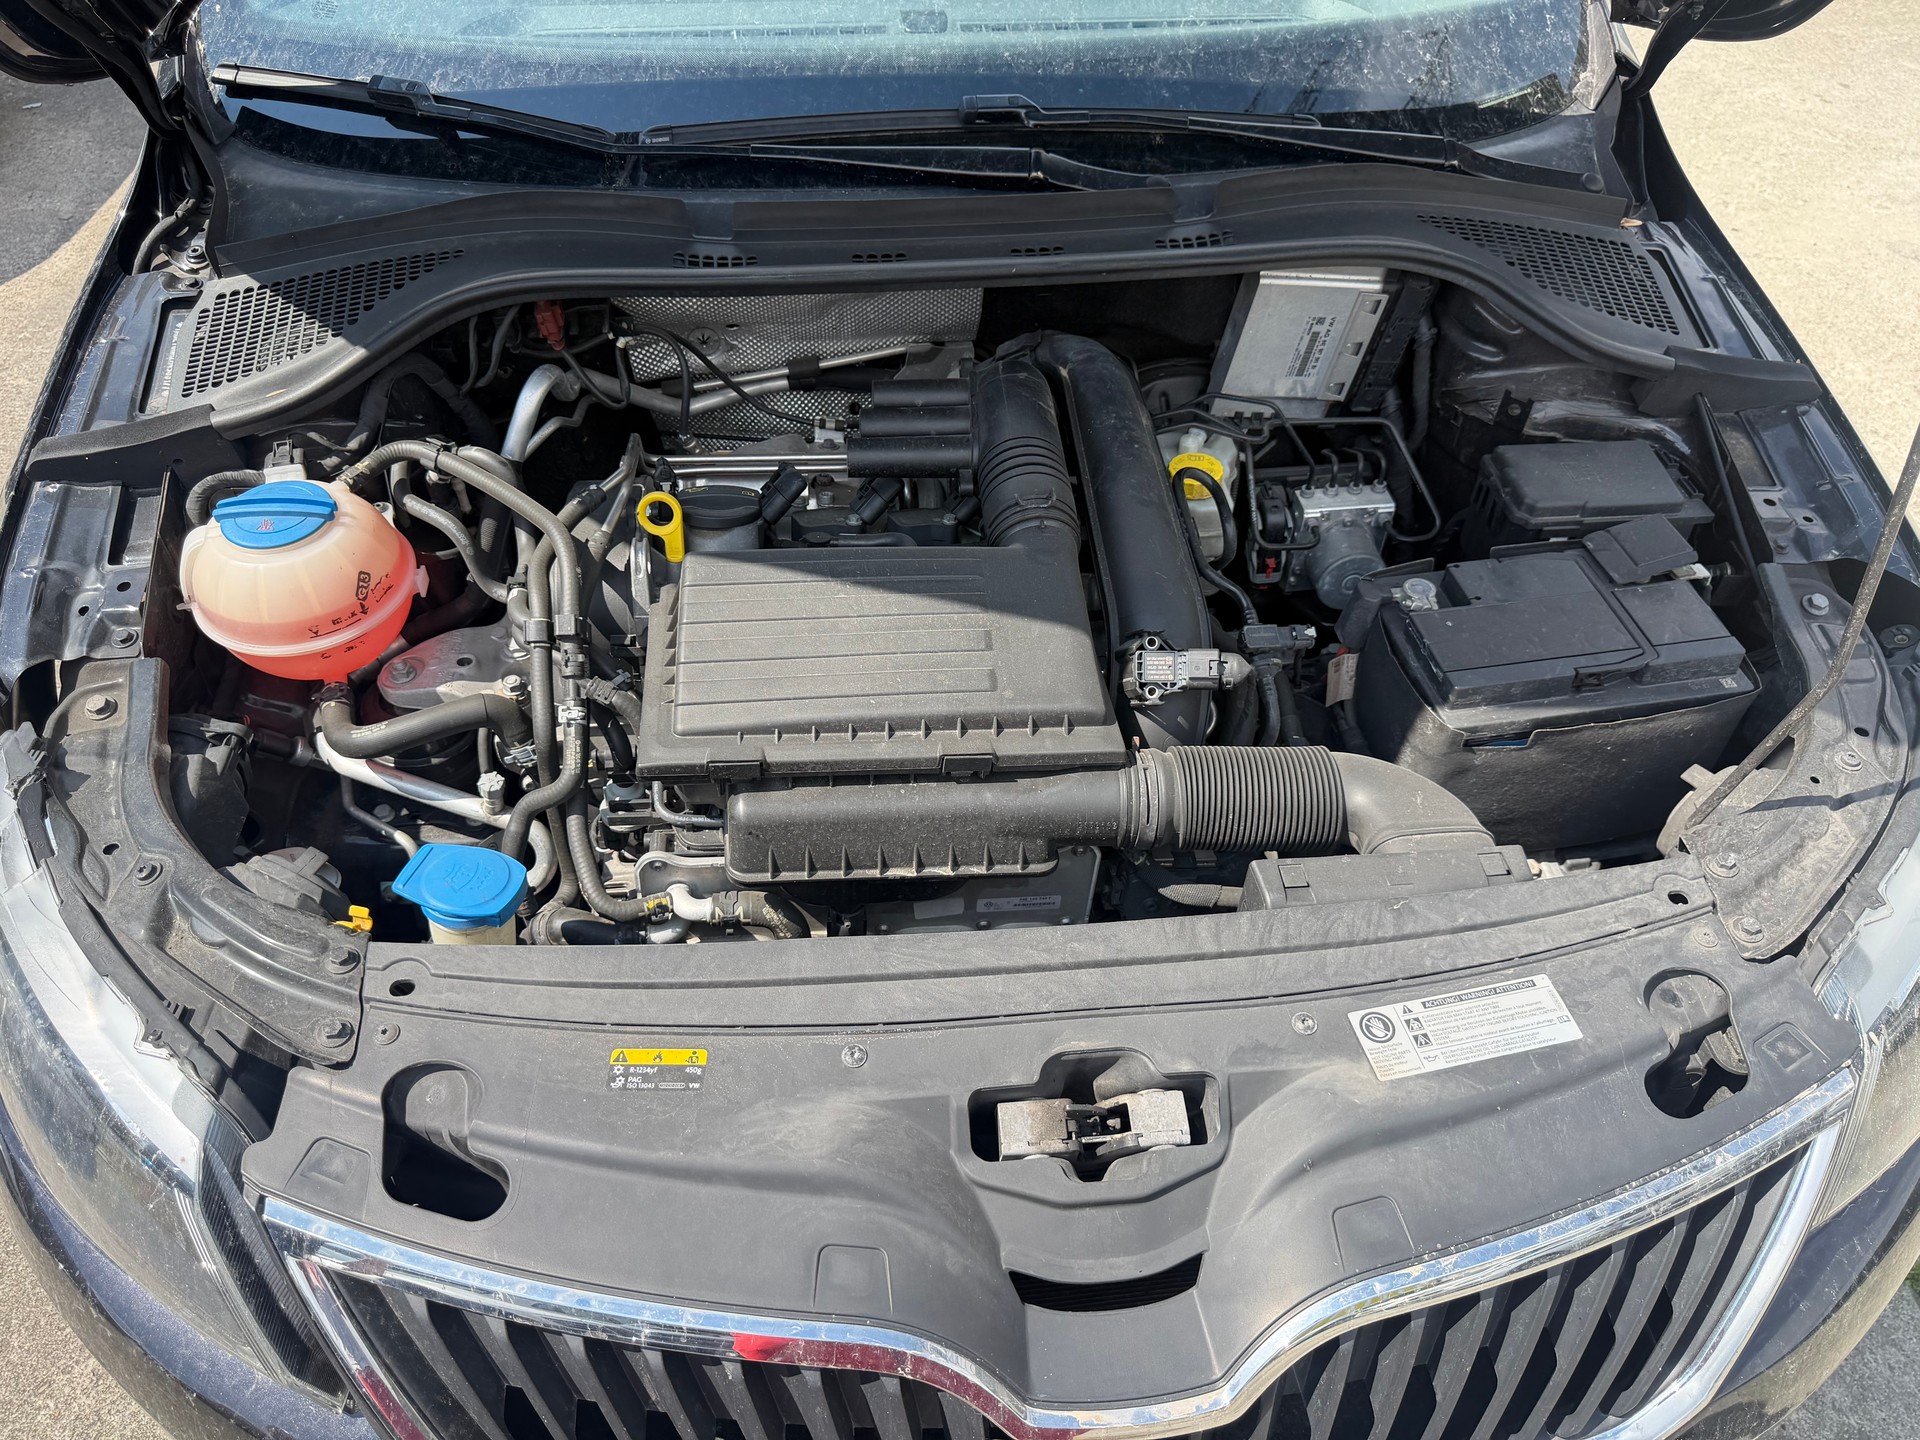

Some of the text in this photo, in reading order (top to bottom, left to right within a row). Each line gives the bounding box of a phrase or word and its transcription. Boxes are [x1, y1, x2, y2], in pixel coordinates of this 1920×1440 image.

[1327, 316, 1337, 328] VW
[1423, 980, 1534, 1007] ACHTUNG! WARNING! ATTENTION!
[629, 1067, 702, 1075] R-1234yf 450g
